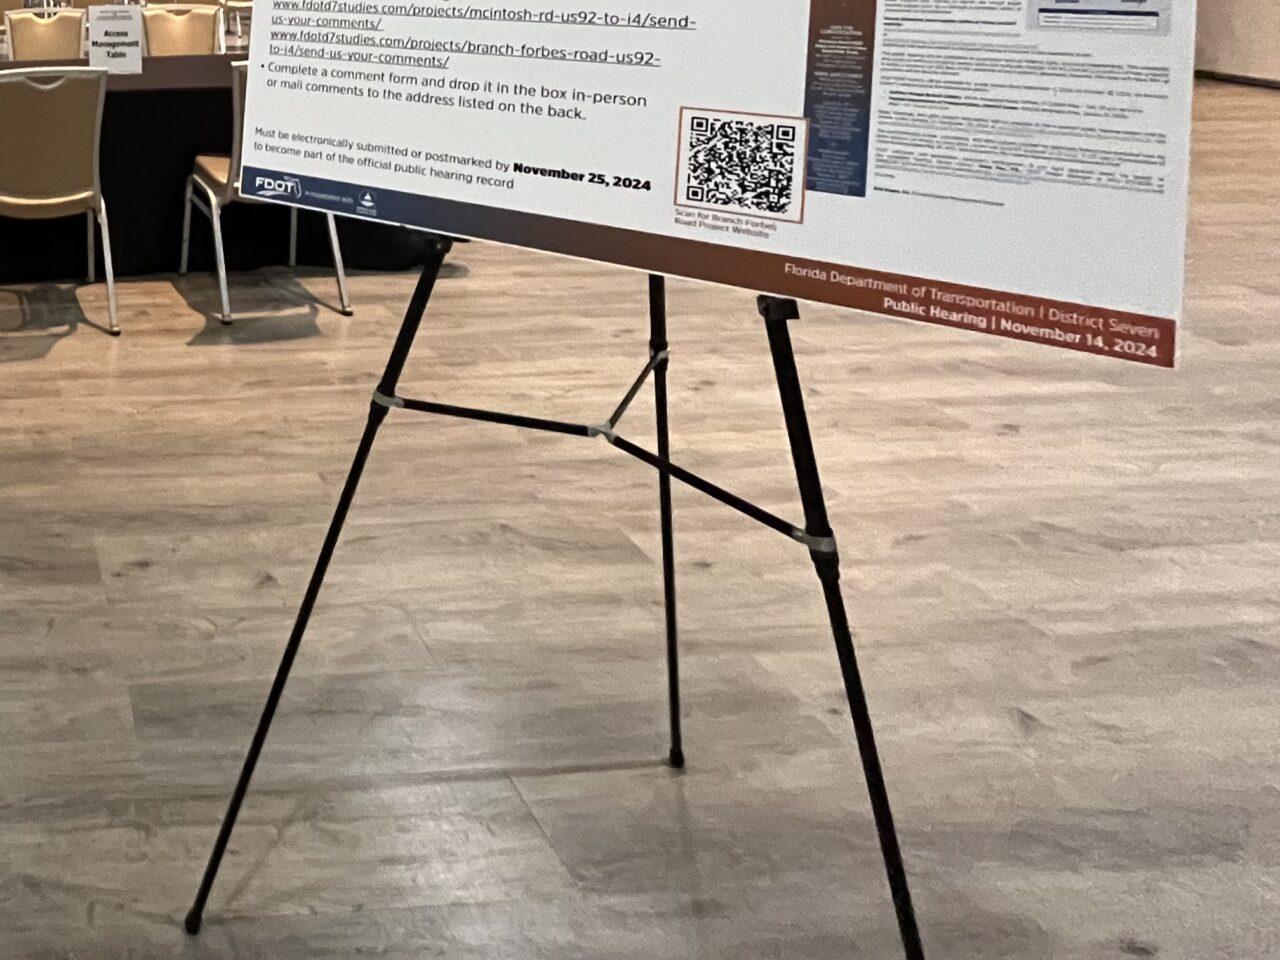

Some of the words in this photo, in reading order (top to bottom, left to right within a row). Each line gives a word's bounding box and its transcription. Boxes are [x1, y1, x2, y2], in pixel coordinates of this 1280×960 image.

[272, 14, 382, 30] us-your-comments/
[273, 0, 696, 29] www.fdotd7studies.com/projects/mcintosh-rd-us92-to-i4/send-
[106, 50, 126, 58] Table
[270, 30, 661, 66] www.fdotd7studies.com/projects/branch-forbes-road-us92-
[270, 44, 450, 69] to-i4/send-us-your-comments/
[266, 78, 278, 88] or
[280, 79, 302, 90] mail
[306, 82, 364, 98] comments
[368, 87, 379, 99] to
[382, 88, 402, 101] the
[406, 90, 455, 106] address
[458, 96, 494, 110] listed
[498, 102, 516, 113] on
[520, 102, 544, 116] the
[548, 104, 587, 120] back.
[268, 62, 318, 76] Complete
[321, 68, 328, 77] a
[330, 68, 384, 82] comment
[388, 72, 418, 86] form
[422, 76, 445, 89] and
[448, 78, 480, 92] drop
[484, 80, 492, 93] it
[497, 82, 508, 94] in
[514, 84, 536, 96] the
[541, 85, 566, 100] box
[572, 88, 647, 107] in-person
[254, 142, 263, 152] to
[265, 143, 302, 156] become
[304, 150, 323, 162] part
[326, 152, 336, 162] of
[338, 153, 354, 164] the
[357, 156, 392, 170] official
[394, 162, 427, 176] public
[430, 168, 472, 184] hearing
[476, 176, 514, 189] record
[256, 126, 276, 138] Must
[278, 130, 290, 140] be
[292, 132, 354, 150] electronically
[356, 142, 408, 157] submitted
[410, 150, 422, 158] or
[424, 151, 492, 169] postmarked
[496, 160, 510, 172] by
[513, 162, 585, 182] November
[588, 172, 610, 187] 25,
[612, 176, 652, 191] 2024
[256, 177, 292, 192] FDOT
[784, 262, 827, 280] Florida
[830, 270, 908, 295] Department
[912, 286, 926, 298] of
[930, 287, 1035, 317] Transportation
[1048, 308, 1104, 331] District
[1108, 318, 1160, 339] Seven
[883, 297, 925, 316] Public
[930, 306, 987, 329] Hearing
[1000, 318, 1080, 343] November
[1114, 338, 1158, 358] 2024
